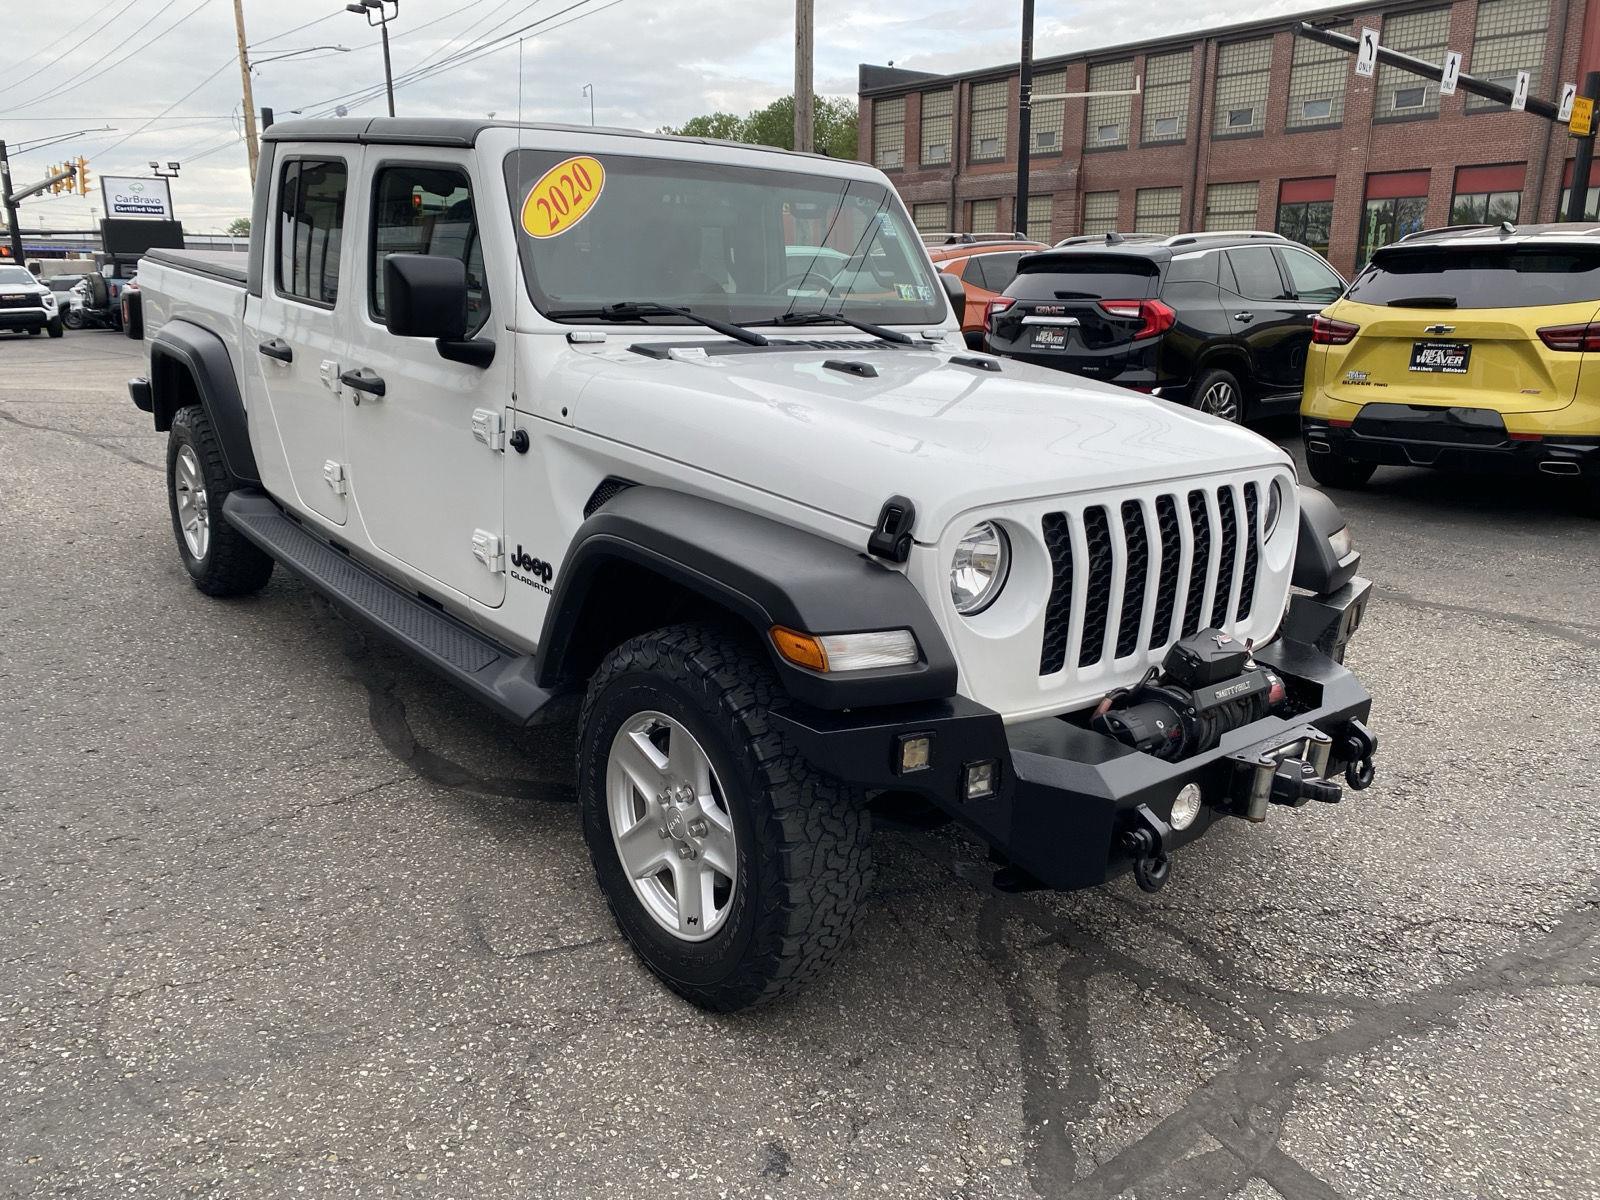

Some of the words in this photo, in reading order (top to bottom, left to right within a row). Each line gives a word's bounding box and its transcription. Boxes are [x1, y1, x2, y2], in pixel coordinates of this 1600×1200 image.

[1359, 62, 1372, 72] ONLY
[1443, 81, 1454, 90] ONLY
[115, 194, 161, 204] CarBravo
[536, 163, 593, 231] 2020
[1035, 305, 1065, 315] GMC
[1420, 349, 1446, 357] RICK
[1415, 355, 1464, 365] WEAVER
[511, 544, 553, 584] Jeep
